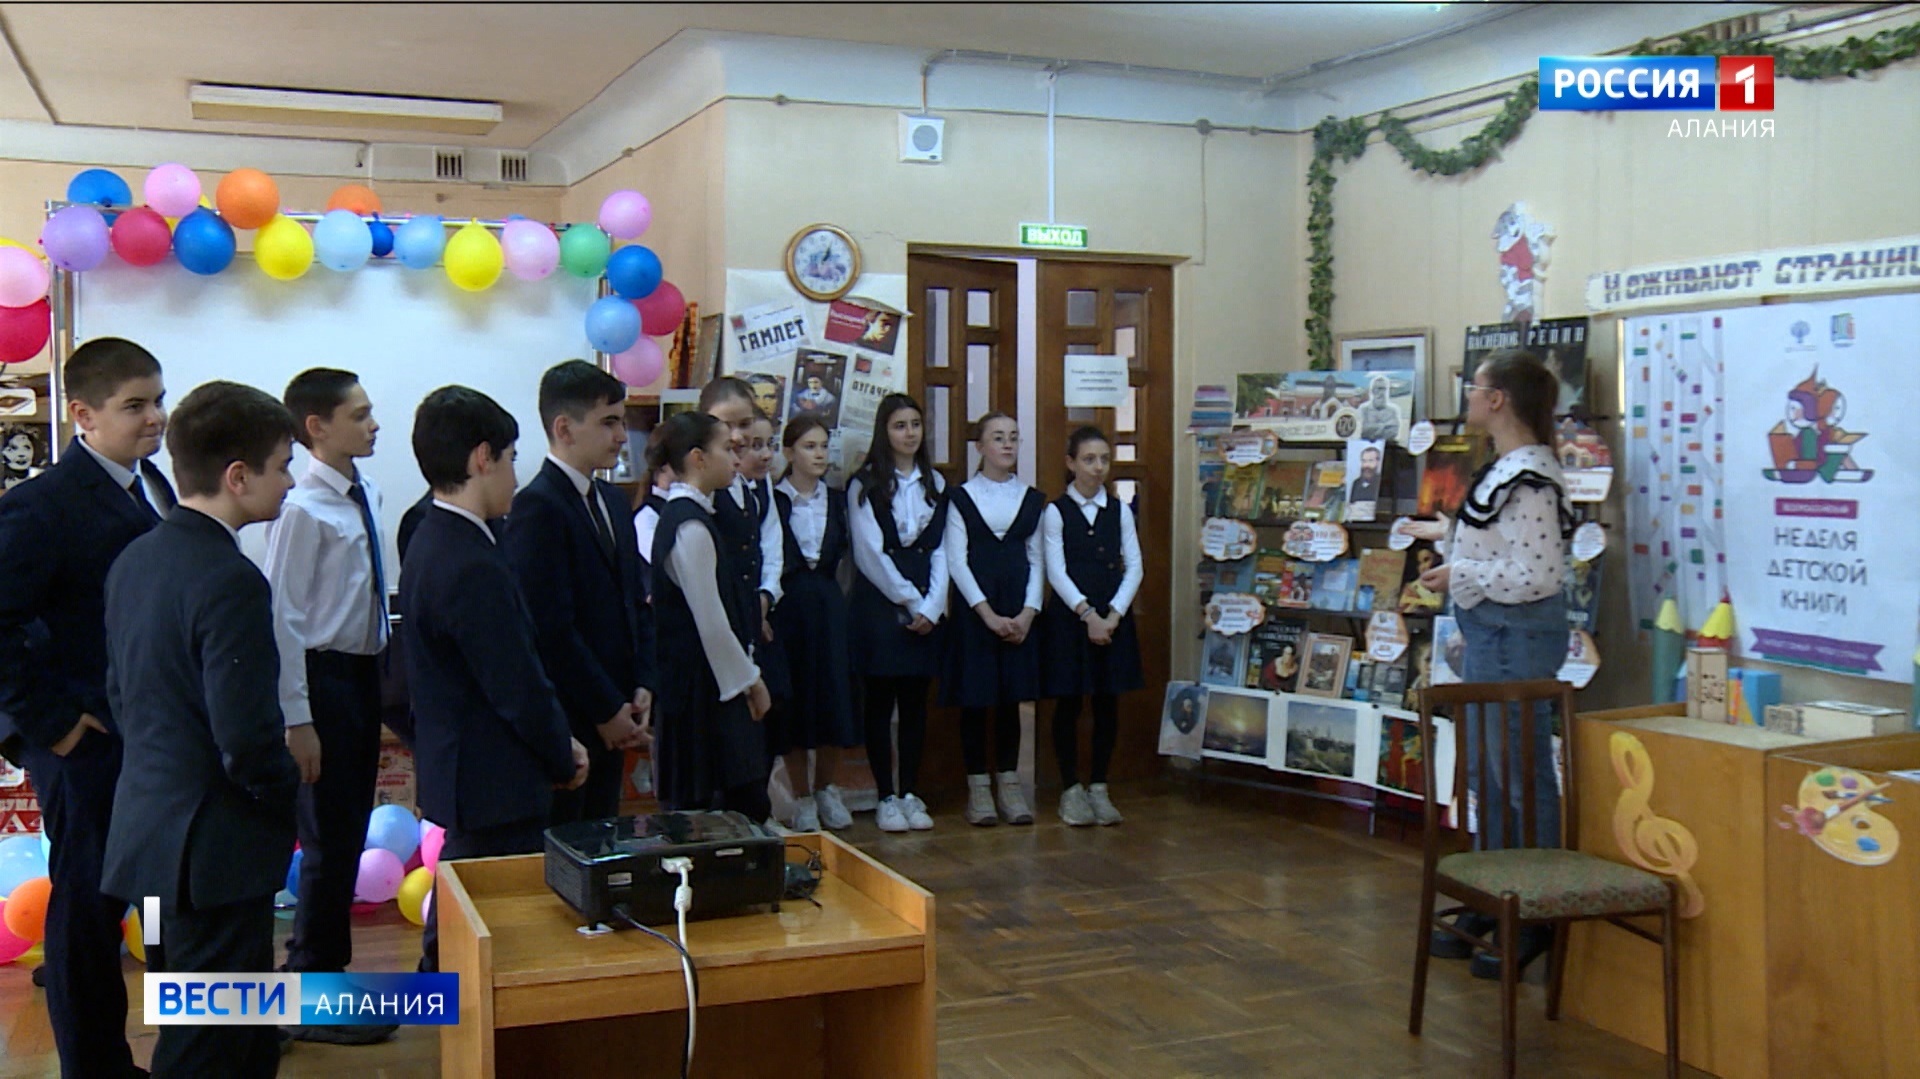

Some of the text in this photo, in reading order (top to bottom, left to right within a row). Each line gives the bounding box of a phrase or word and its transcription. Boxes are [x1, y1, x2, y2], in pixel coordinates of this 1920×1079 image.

[1027, 228, 1083, 246] ВЫХОД
[1626, 260, 1761, 299] ОЖИВАЮТ
[737, 318, 805, 353] ГАМЛЕТ
[1774, 526, 1858, 552] НЕДЕЛЯ
[1766, 558, 1868, 586] ДЕТСКОЙ
[1780, 589, 1848, 616] КНИГИ
